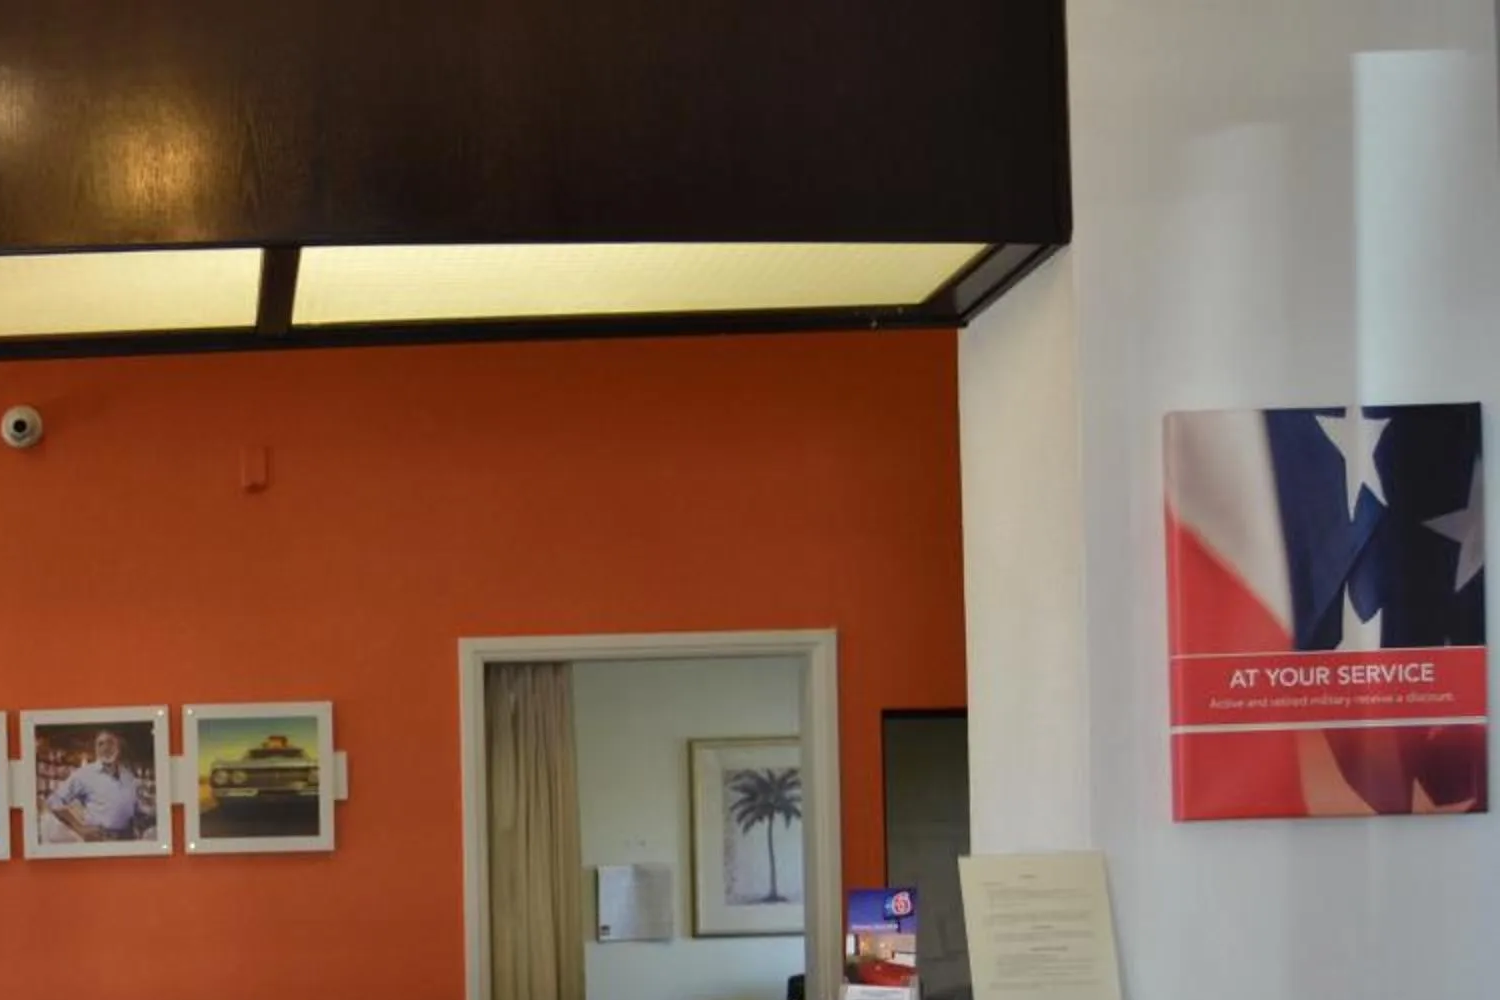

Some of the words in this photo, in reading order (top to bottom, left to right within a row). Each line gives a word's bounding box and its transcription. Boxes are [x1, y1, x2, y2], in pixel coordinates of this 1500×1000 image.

[1230, 668, 1260, 689] AT
[1265, 666, 1330, 687] YOUR
[1336, 663, 1435, 686] SERVICE
